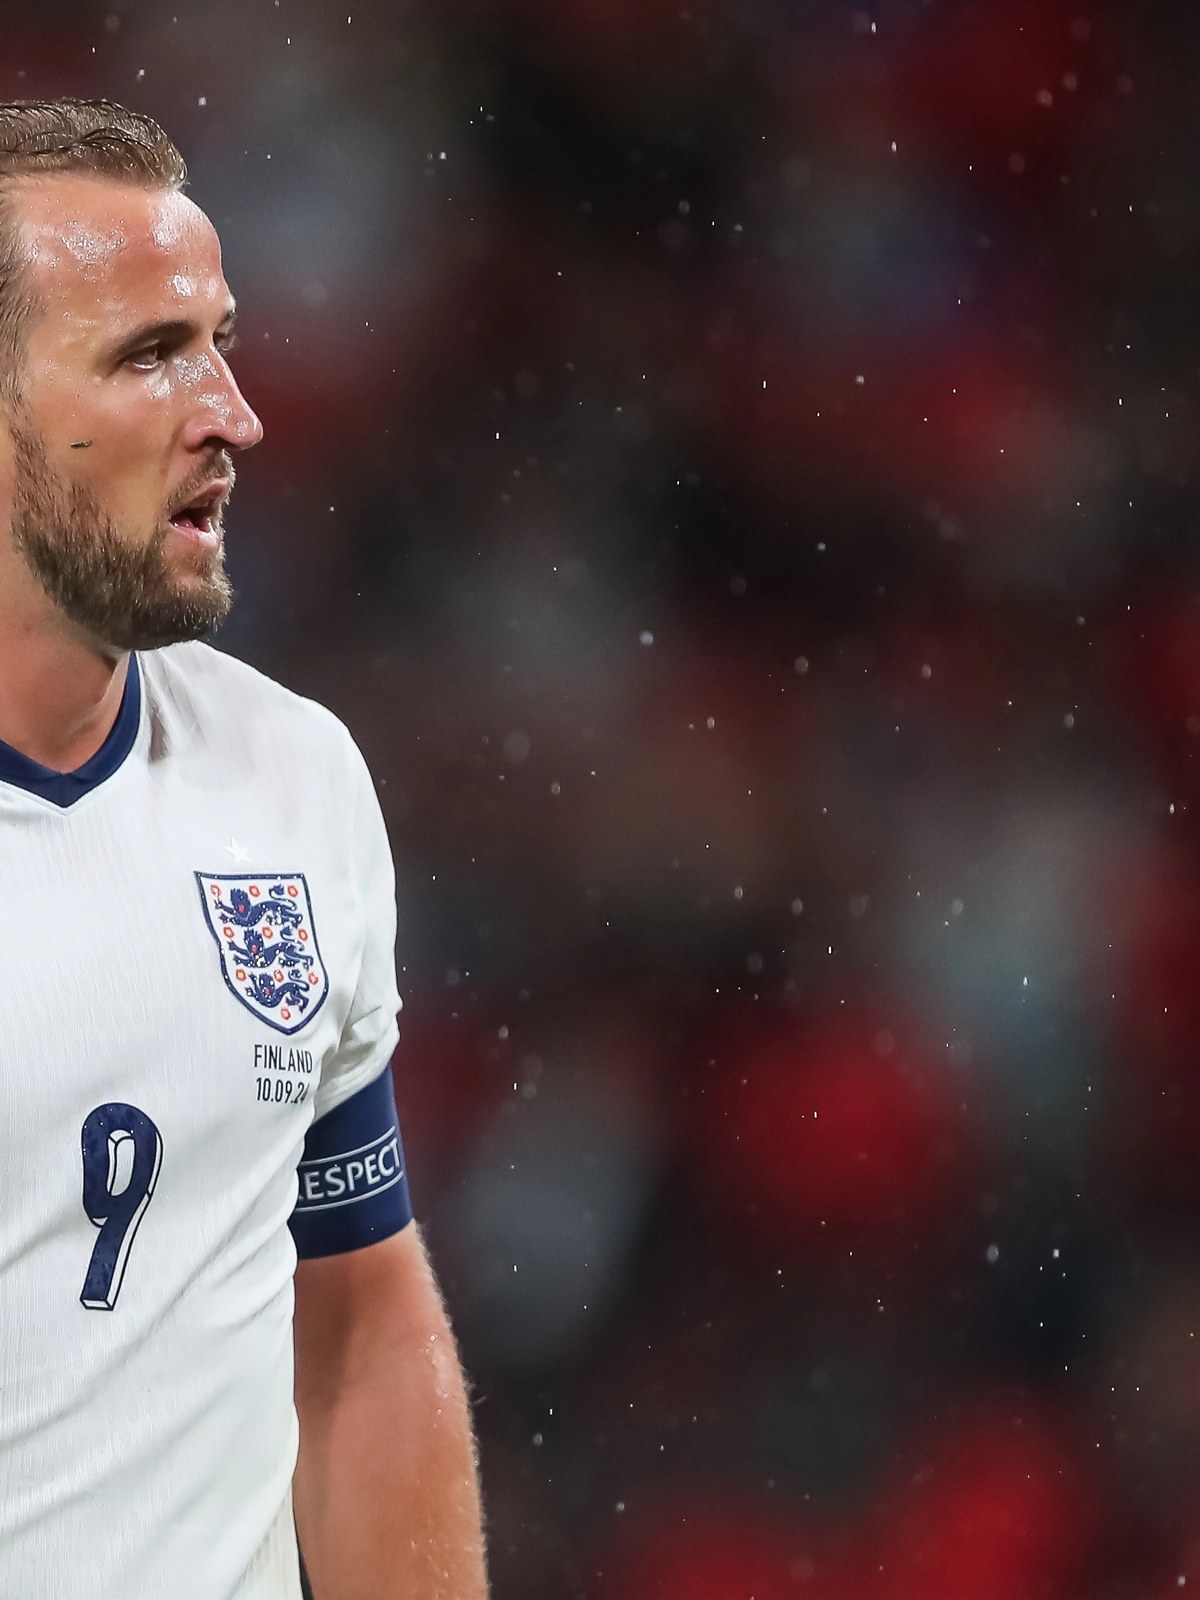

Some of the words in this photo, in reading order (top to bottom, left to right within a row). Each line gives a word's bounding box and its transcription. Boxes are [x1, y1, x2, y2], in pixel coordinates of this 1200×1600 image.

[254, 1044, 313, 1074] FINLAND
[299, 1137, 400, 1200] ESPECT
[80, 1103, 164, 1311] 9
